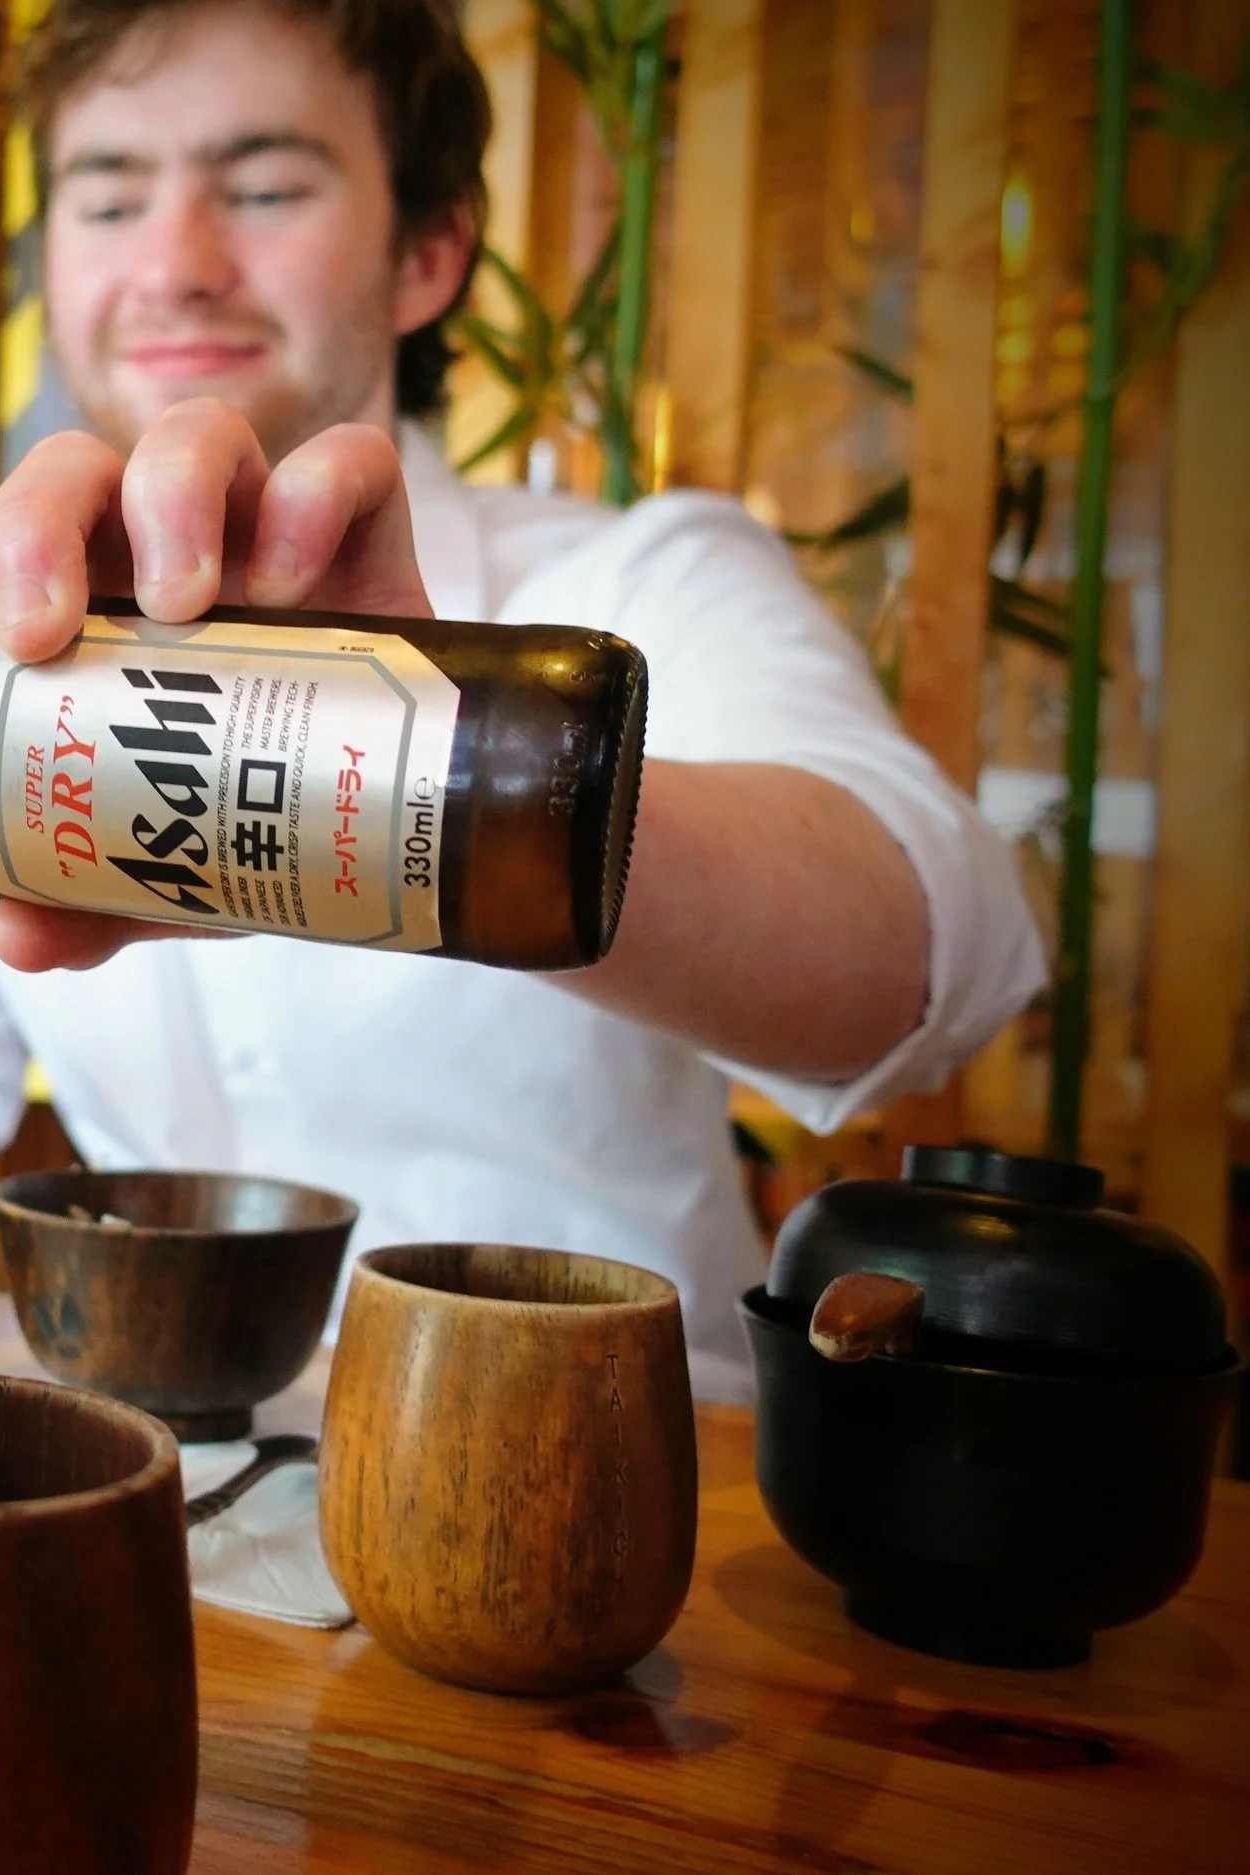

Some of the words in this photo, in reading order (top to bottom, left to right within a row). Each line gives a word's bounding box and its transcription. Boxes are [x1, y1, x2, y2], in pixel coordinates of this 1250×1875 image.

[230, 675, 246, 713] QUALITY
[243, 677, 264, 732] SUPERVISION
[224, 713, 237, 739] HIGH
[241, 732, 252, 750] THE
[260, 715, 273, 750] MASTER
[277, 708, 294, 752] BREWING
[297, 710, 310, 743] CLEAN
[223, 739, 234, 753] TO
[24, 744, 46, 835] SUPER
[106, 667, 223, 915] Asahi
[218, 753, 231, 802] PRECISION
[291, 777, 302, 801] AND
[217, 803, 228, 828] WITH
[231, 758, 286, 872] 辛口
[289, 800, 300, 830] TASTE
[333, 744, 365, 897] スーパードライ
[217, 828, 228, 862] BREWED
[288, 831, 299, 856] CRISP
